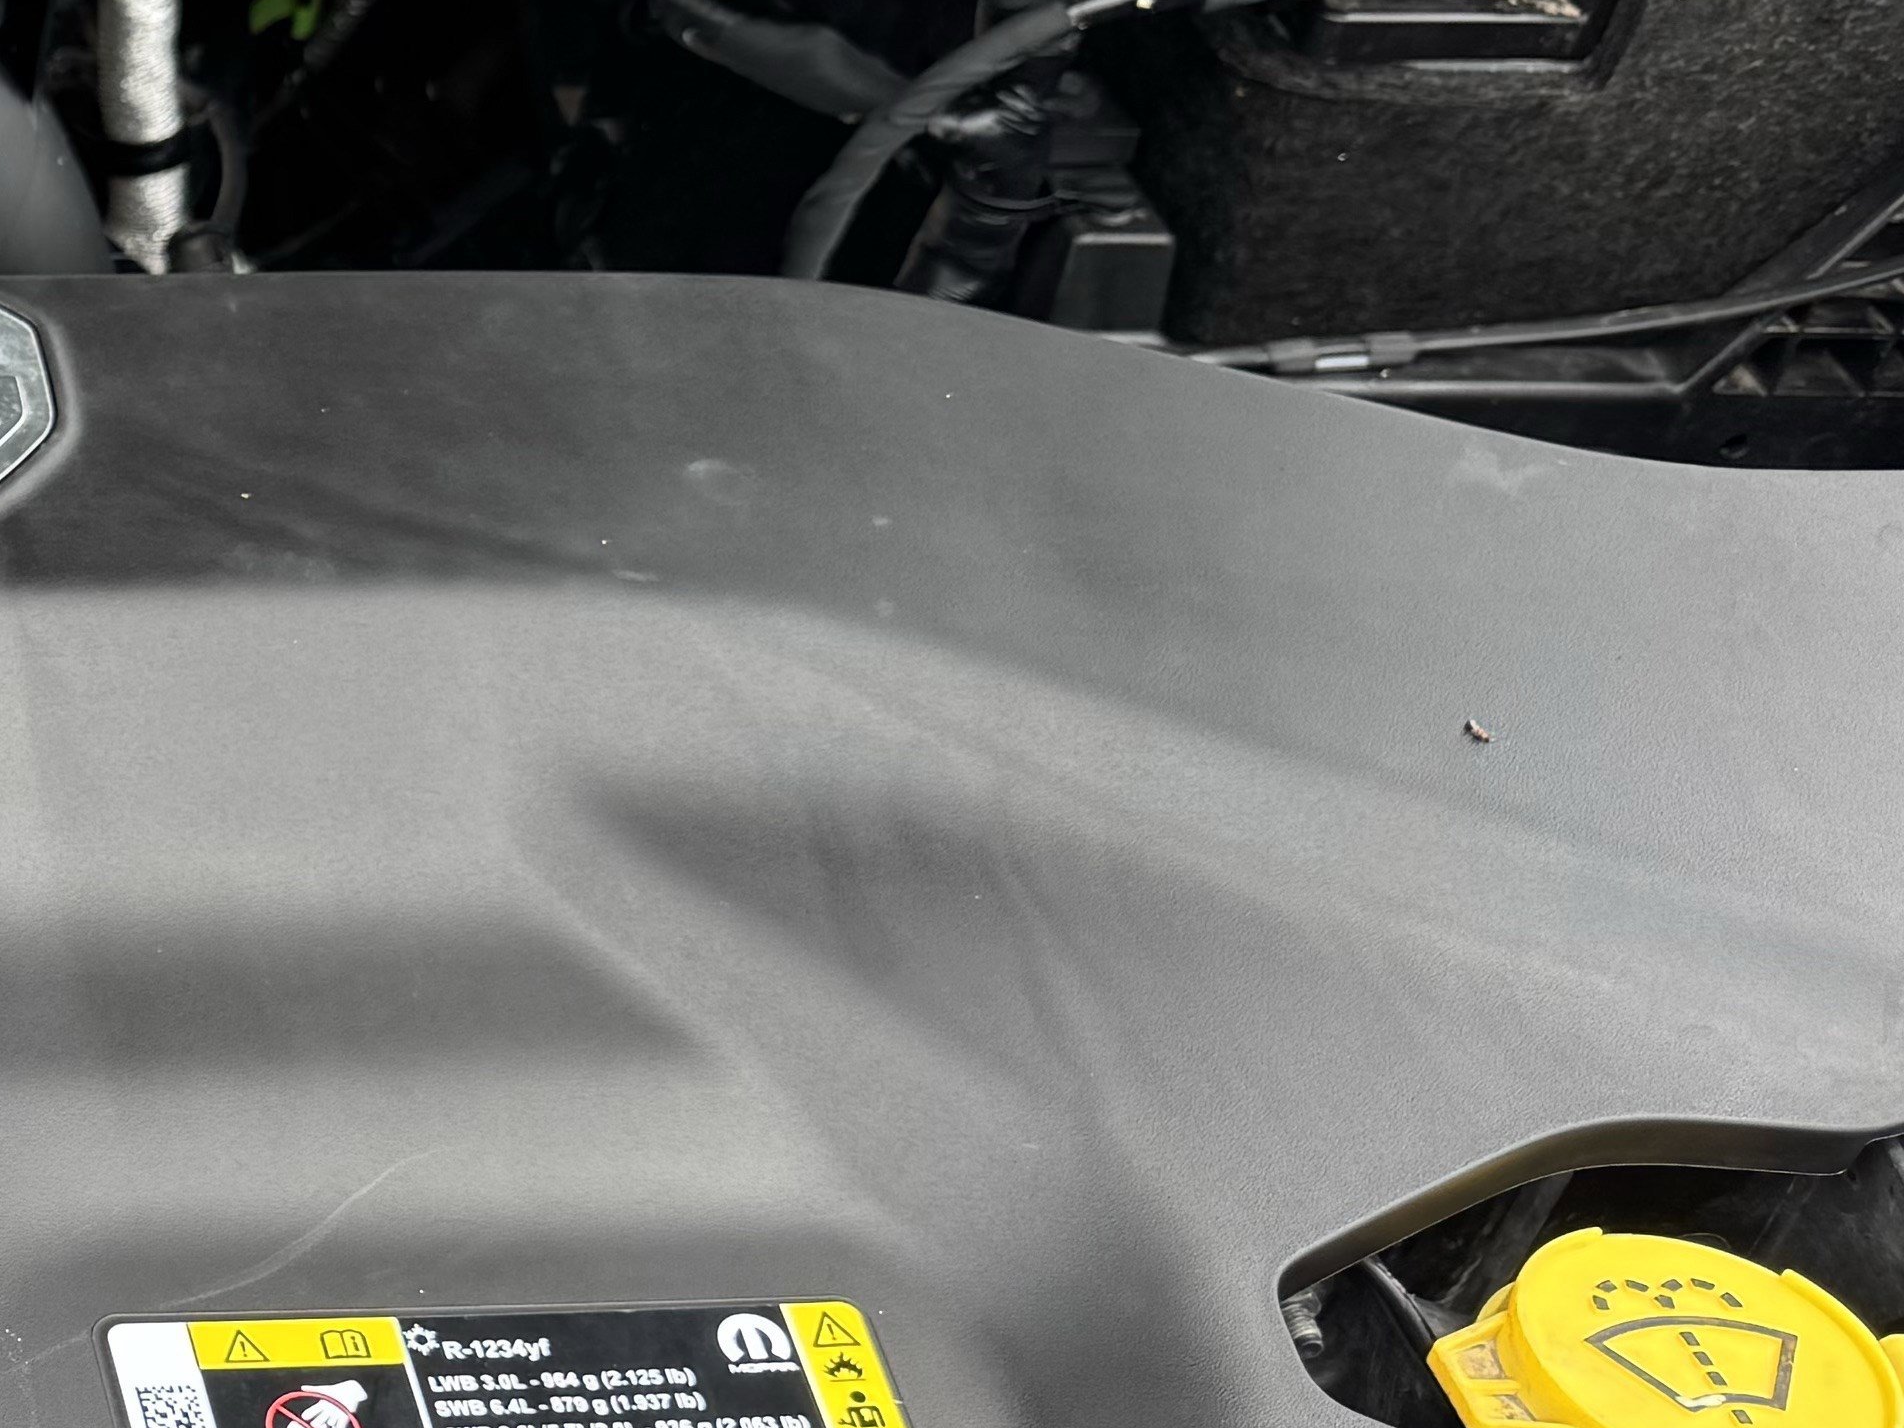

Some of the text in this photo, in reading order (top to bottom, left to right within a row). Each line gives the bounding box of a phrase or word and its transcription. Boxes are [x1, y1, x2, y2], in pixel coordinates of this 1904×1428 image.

[442, 1337, 551, 1362] R-1234yf
[427, 1374, 479, 1393] LWB
[480, 1373, 528, 1391] 3.0L
[601, 1369, 665, 1390] (2.125
[434, 1399, 488, 1418] SWB
[489, 1397, 538, 1416] 6.4L
